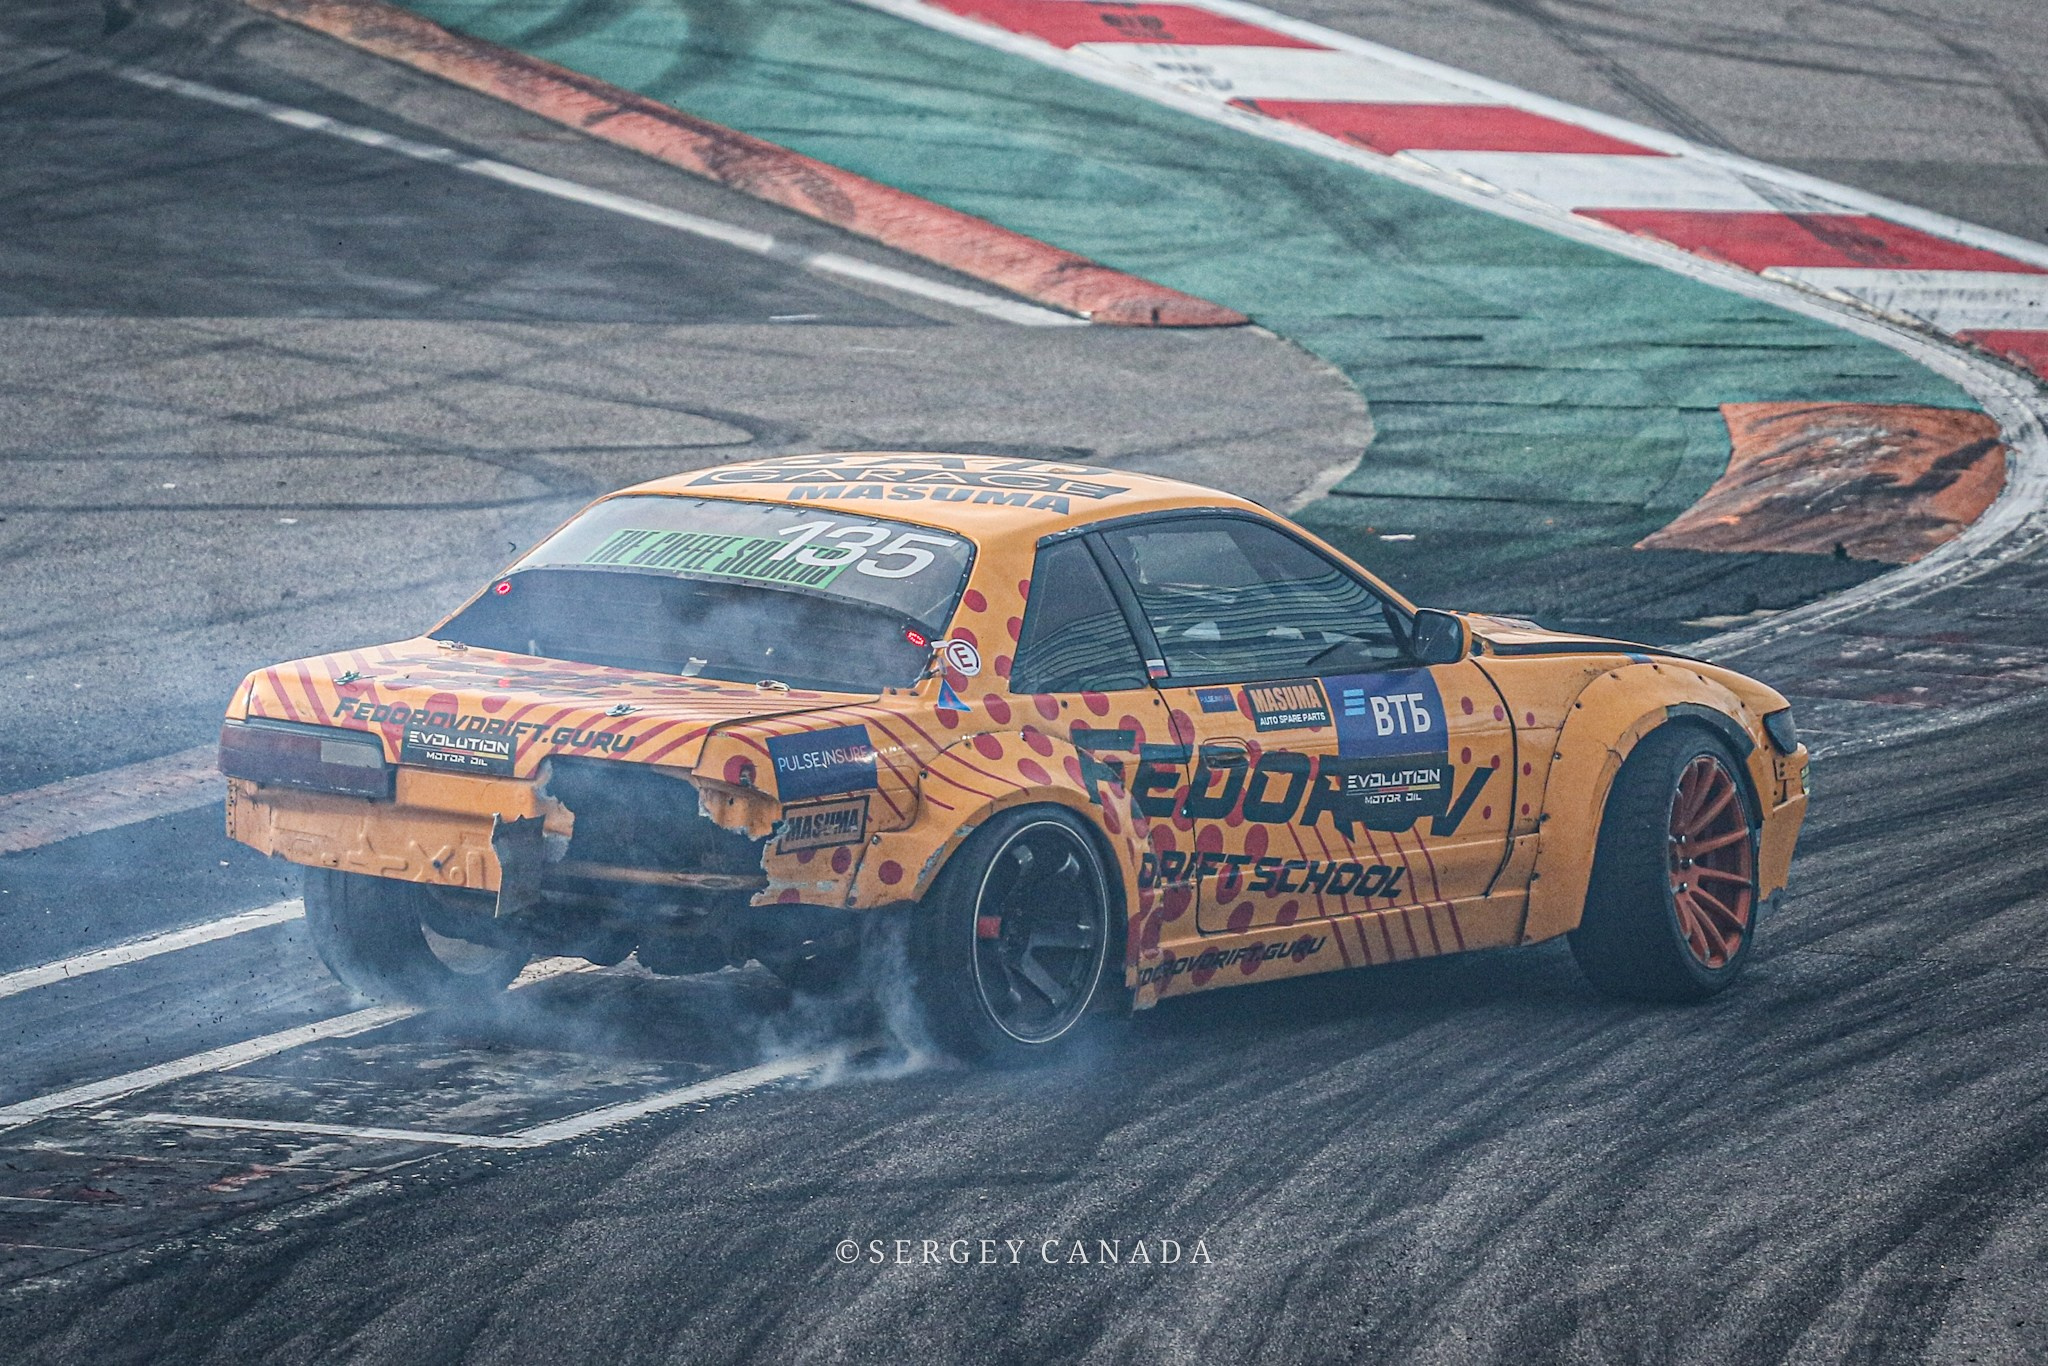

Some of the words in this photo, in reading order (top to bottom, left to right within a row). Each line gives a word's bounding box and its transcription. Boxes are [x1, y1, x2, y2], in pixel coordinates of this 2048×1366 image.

[710, 468, 1107, 497] GARAGE
[787, 484, 1071, 515] MASUMA
[585, 529, 659, 563] THE
[631, 532, 744, 570] COFFEE
[778, 520, 959, 578] 135
[953, 647, 973, 668] E
[1249, 684, 1323, 713] MASUMA
[333, 696, 647, 754] FEDOROVDRIFT.GURU
[1260, 716, 1278, 726] AUTO
[1279, 714, 1302, 725] SPARE
[1302, 712, 1326, 723] PARTS
[1370, 693, 1432, 736] ВТБ
[407, 730, 510, 755] EVOLUTION
[426, 751, 466, 764] MOTOR
[470, 757, 488, 767] OIL
[1347, 769, 1441, 789] EVOLUTION
[1364, 794, 1401, 804] MOTOR
[1405, 792, 1422, 801] OIL
[784, 808, 860, 842] MASUMA
